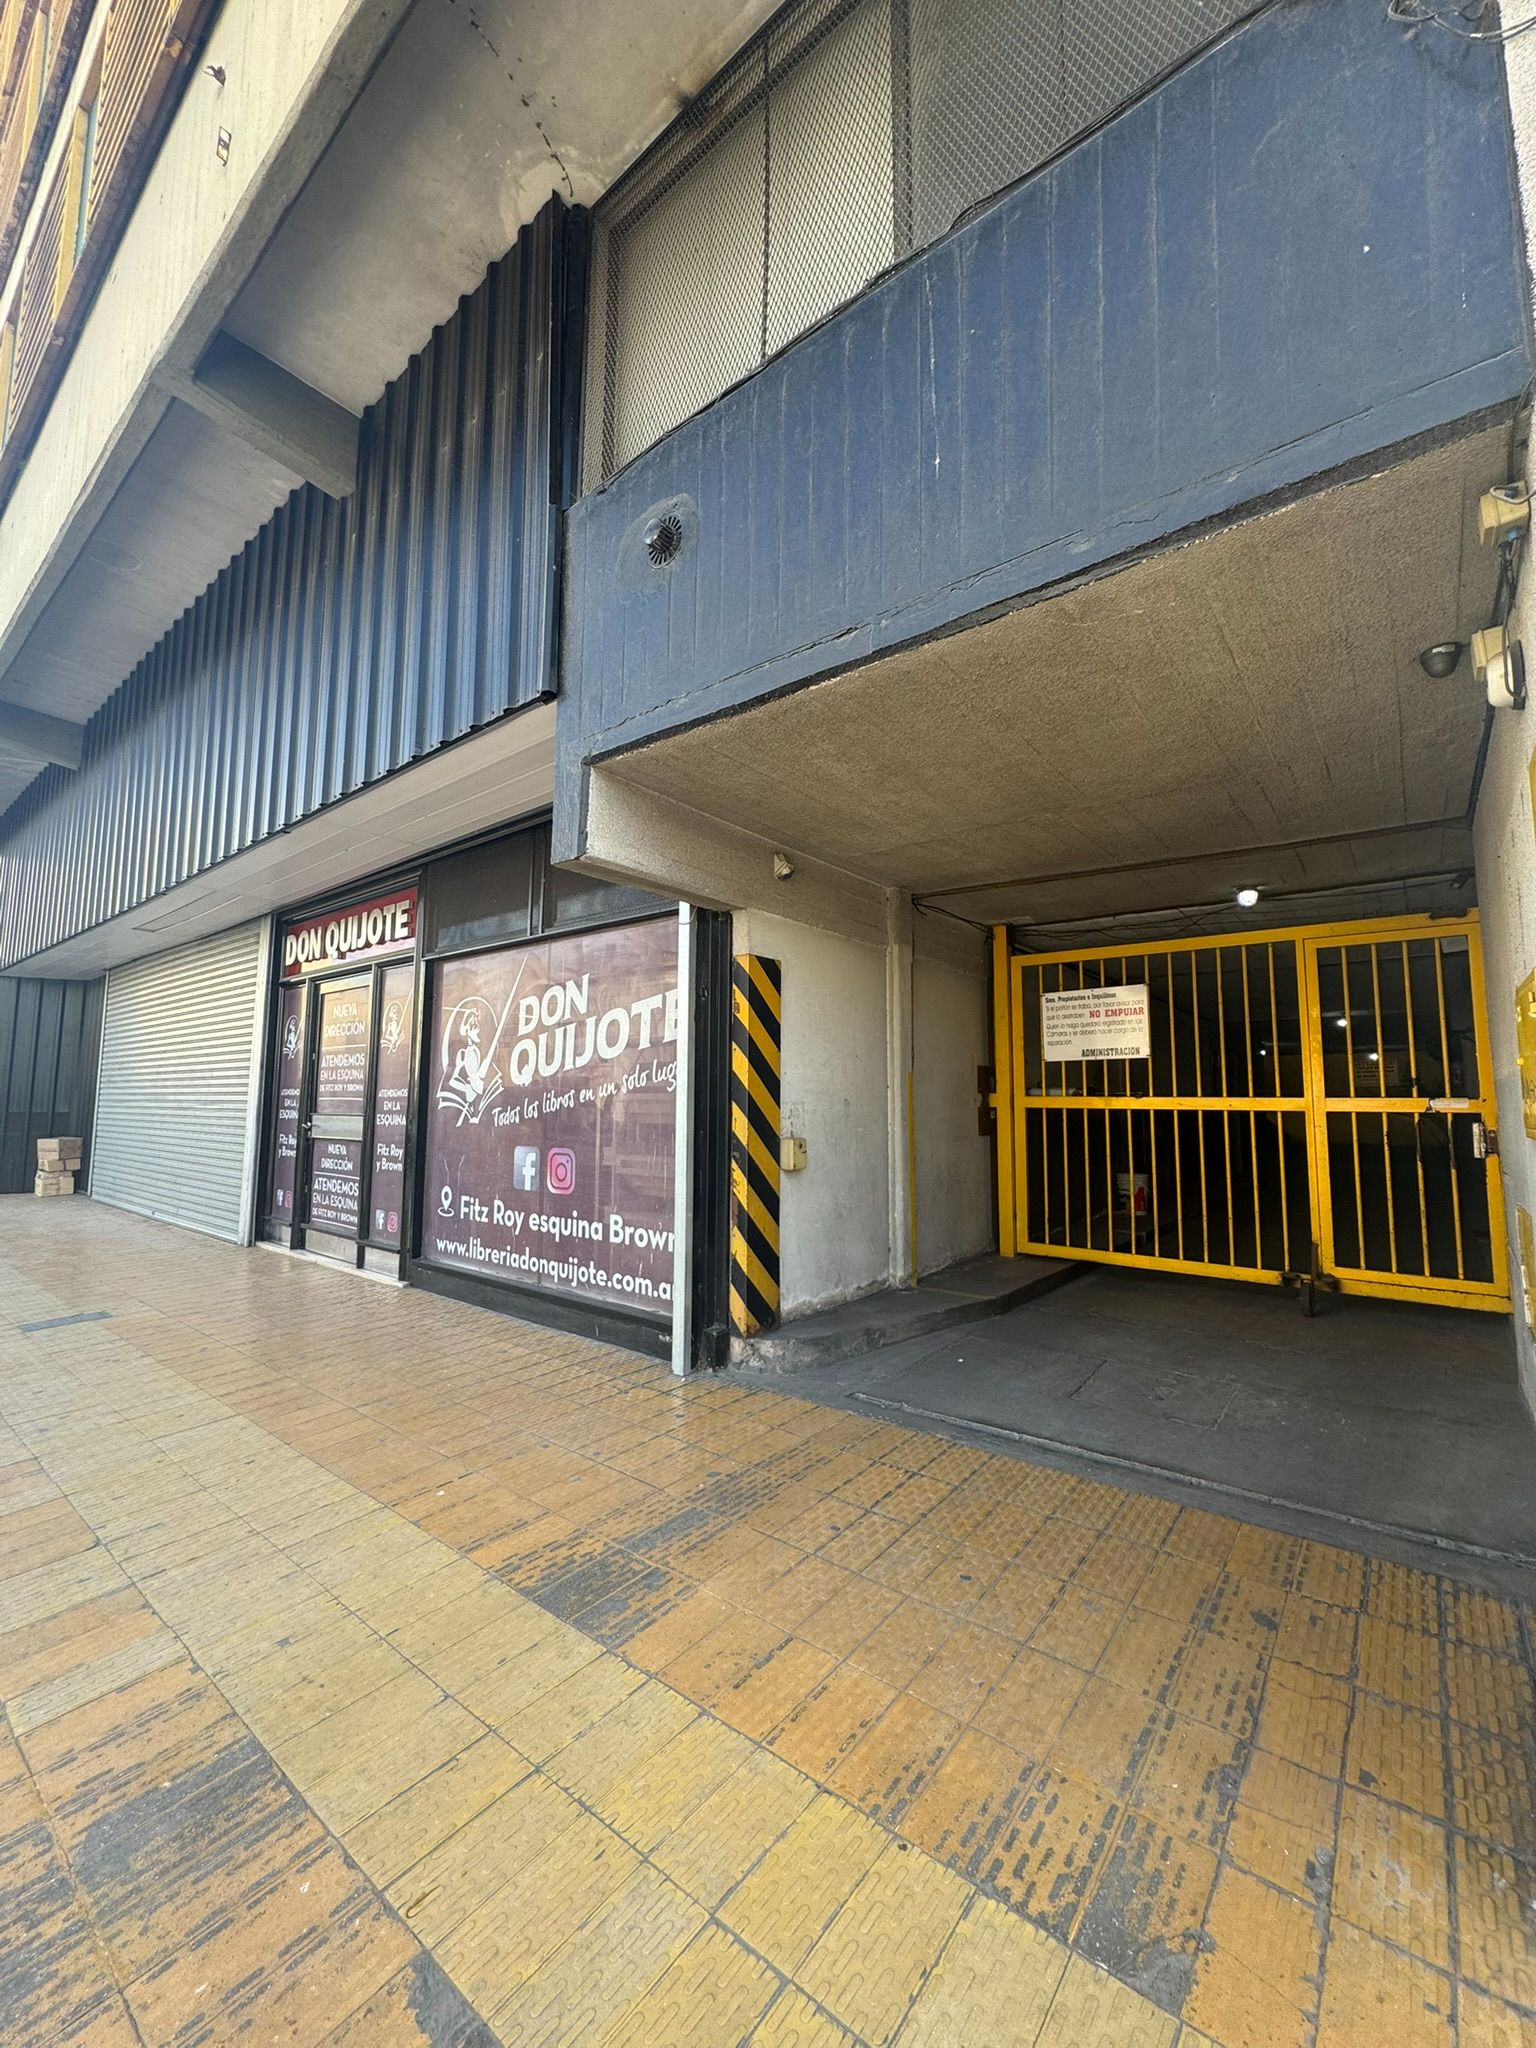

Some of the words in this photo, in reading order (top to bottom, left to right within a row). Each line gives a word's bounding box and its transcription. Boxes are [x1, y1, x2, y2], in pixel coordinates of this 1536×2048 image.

[285, 926, 322, 966] DON
[325, 900, 410, 959] QUIJOTE
[333, 1003, 357, 1018] NUEVA
[517, 973, 590, 1036] DON
[1089, 1009, 1101, 1019] NO
[325, 1017, 366, 1037] DIRECCIÓN
[510, 988, 678, 1087] QUIJOTE
[1081, 1047, 1140, 1058] ADMINISTRACION
[321, 1053, 365, 1068] ATENDEMOS
[320, 1070, 328, 1081] EN
[329, 1070, 336, 1080] LA
[337, 1069, 364, 1082] ESQUINA
[281, 1088, 300, 1096] ATENDEMO
[378, 1088, 408, 1098] ATENDEMOS
[492, 1105, 520, 1127] Todos
[524, 1099, 539, 1119] los
[543, 1088, 575, 1113] libros
[579, 1089, 595, 1103] en
[599, 1079, 617, 1098] un
[621, 1064, 648, 1094] solo
[652, 1058, 677, 1092] lug
[383, 1101, 392, 1111] EN
[392, 1101, 401, 1111] LA
[279, 1109, 299, 1120] ESQUIN
[376, 1114, 406, 1127] ESQUINA
[328, 1143, 347, 1155] NUEVA
[377, 1143, 390, 1156] Fitz
[390, 1143, 404, 1160] Roy
[321, 1157, 353, 1171] DIRECCIÓN
[376, 1160, 381, 1173] y
[381, 1157, 403, 1171] Brown
[313, 1177, 359, 1196] ATENDEMOS
[312, 1192, 321, 1204] EN
[321, 1194, 329, 1205] LA
[330, 1195, 358, 1211] ESQUINA
[459, 1194, 489, 1223] Fitz
[493, 1199, 525, 1235] Roy
[528, 1210, 603, 1242] esquina
